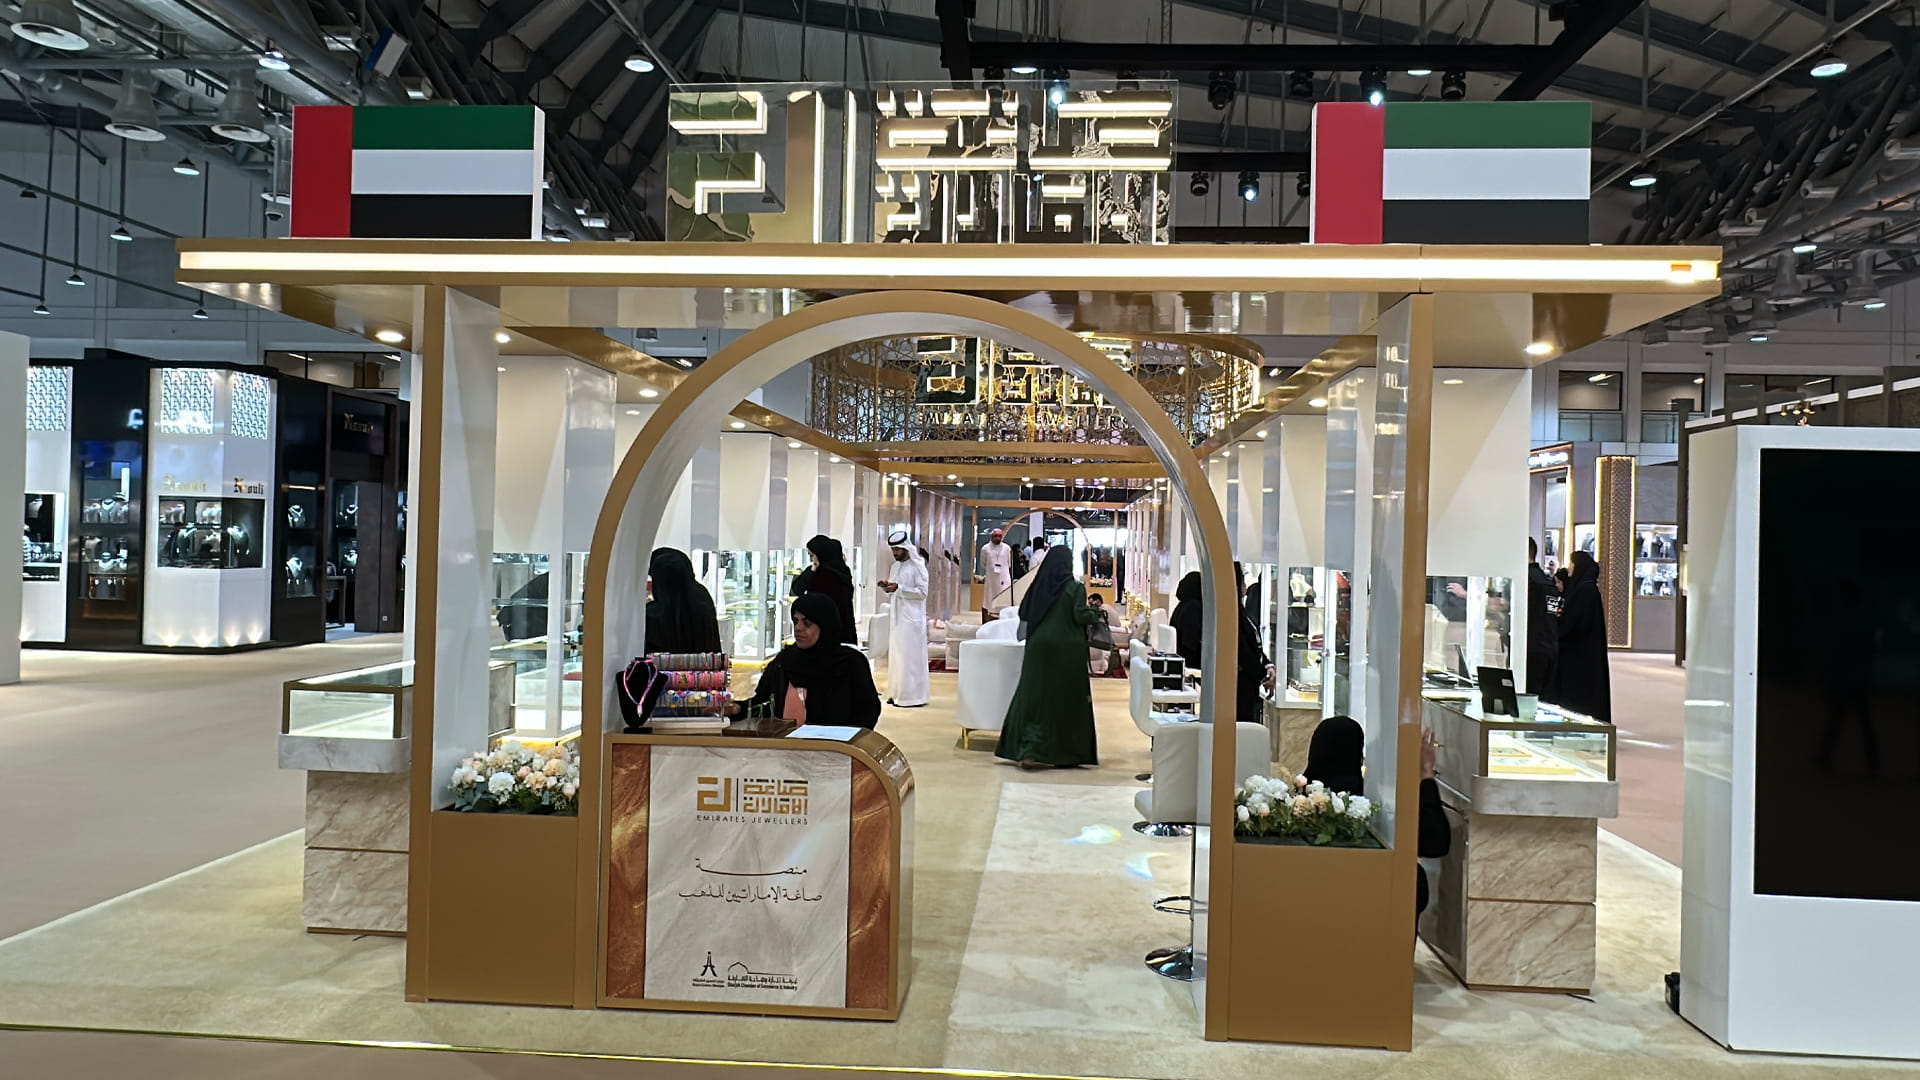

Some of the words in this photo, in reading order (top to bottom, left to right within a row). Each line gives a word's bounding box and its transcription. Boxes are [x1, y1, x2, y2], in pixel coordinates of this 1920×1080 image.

[697, 815, 746, 823] EMIRATES
[752, 817, 808, 825] JEWELLERS
[695, 858, 807, 877] منصة
[678, 883, 725, 902] للذهب
[726, 883, 781, 904] الإماراتيين
[782, 888, 823, 902] صاغة
